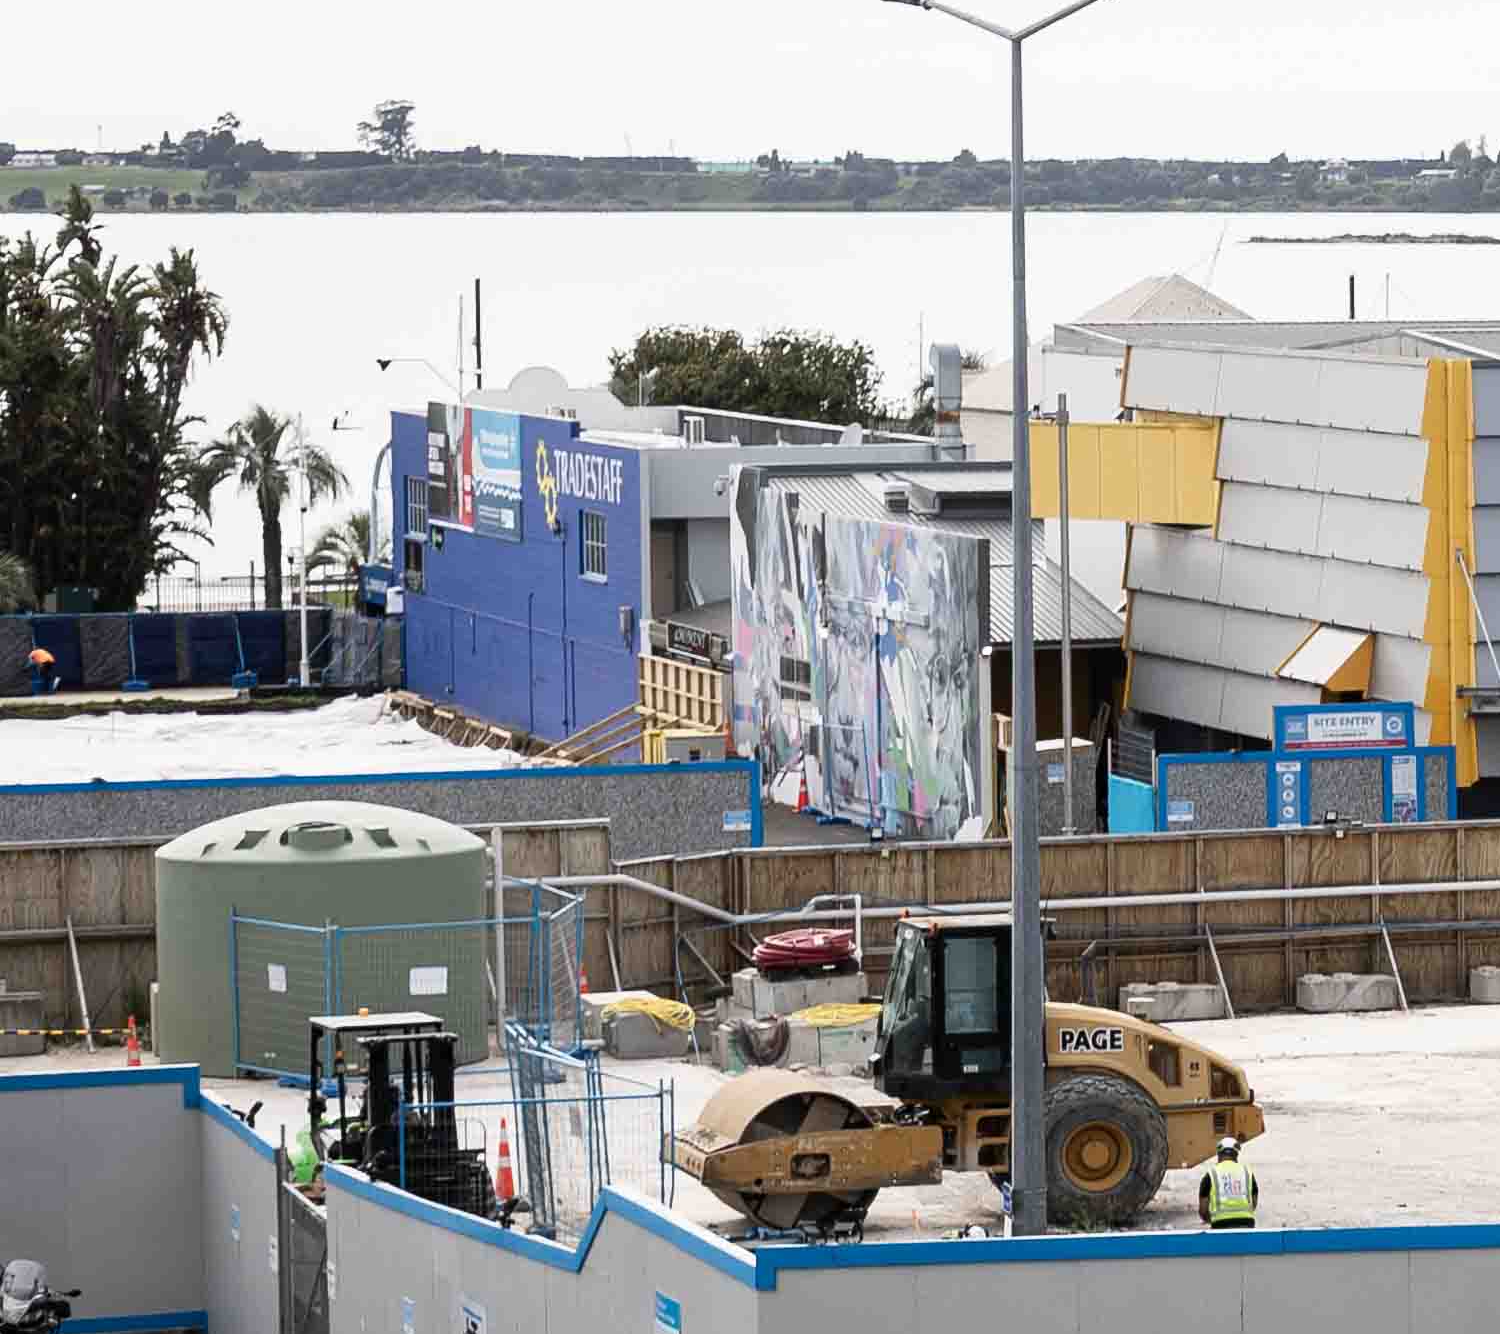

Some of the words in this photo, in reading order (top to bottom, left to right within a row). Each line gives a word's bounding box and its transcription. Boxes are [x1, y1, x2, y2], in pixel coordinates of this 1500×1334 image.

[553, 450, 624, 505] TRADESTAFF
[1313, 717, 1337, 728] SITE
[1339, 715, 1377, 727] ENTRY
[1060, 1029, 1123, 1051] PAGE
